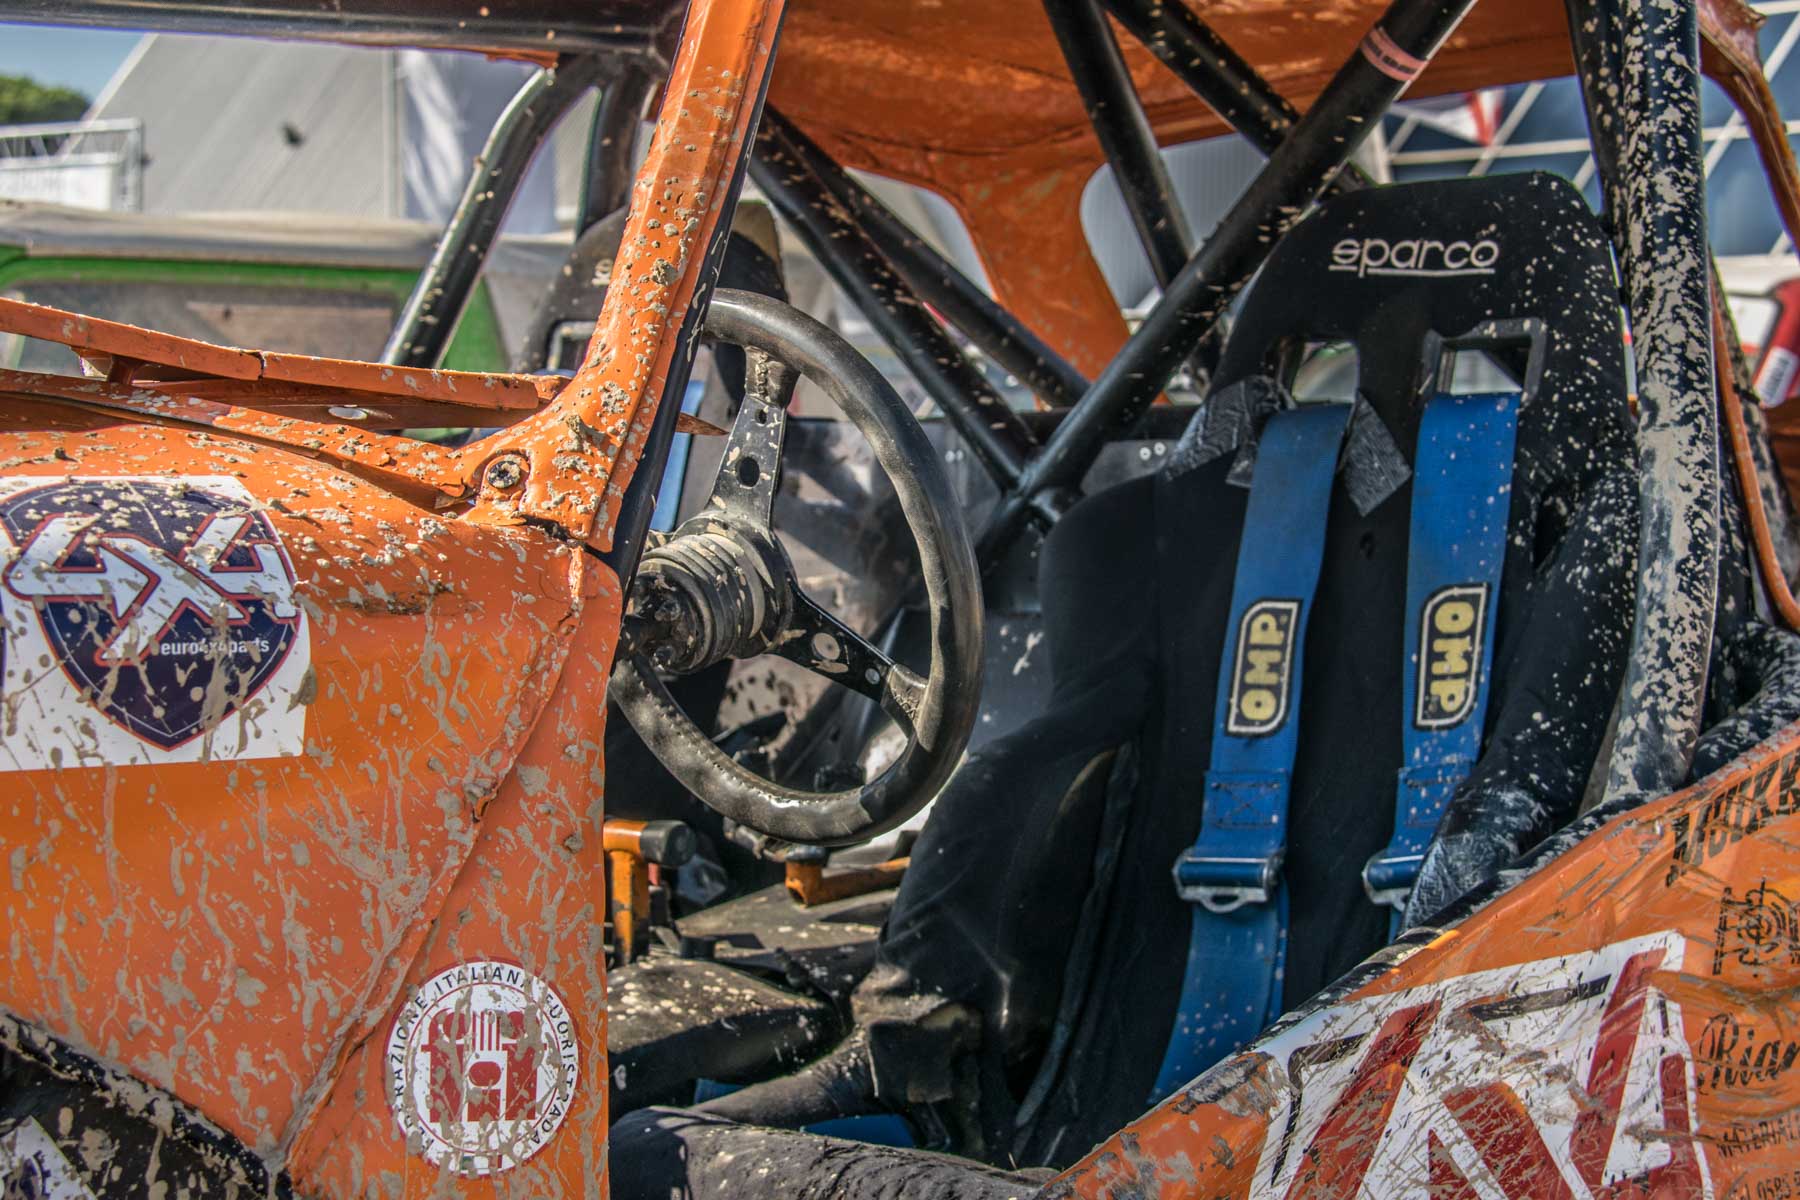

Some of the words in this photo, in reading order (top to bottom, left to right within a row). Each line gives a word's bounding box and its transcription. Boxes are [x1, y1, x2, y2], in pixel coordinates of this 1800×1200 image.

[1330, 237, 1500, 279] sparco
[160, 636, 270, 658] euro4x4pats
[1240, 612, 1285, 721] OMP
[1429, 600, 1475, 713] OMP
